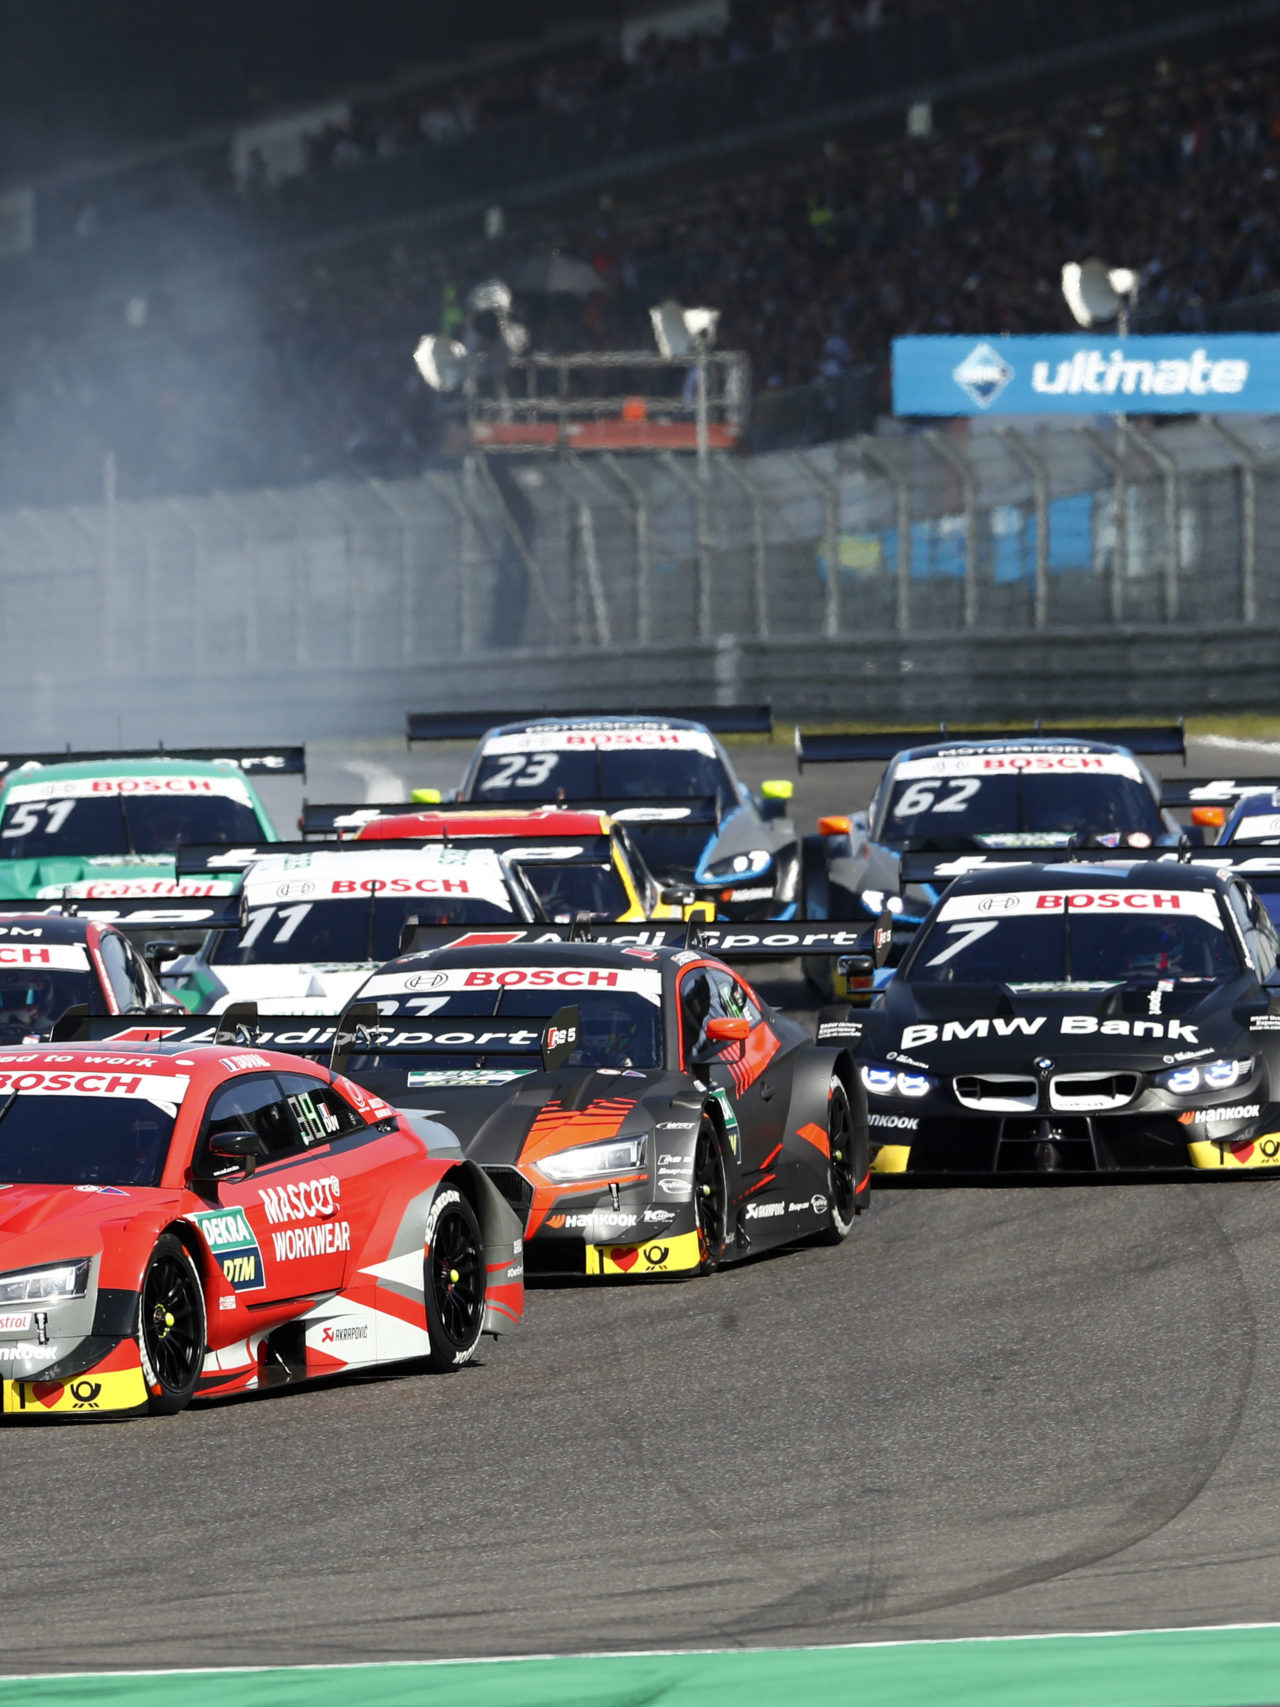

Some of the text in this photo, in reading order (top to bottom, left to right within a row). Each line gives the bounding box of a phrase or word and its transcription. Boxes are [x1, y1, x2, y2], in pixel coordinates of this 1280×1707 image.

[1031, 349, 1249, 394] ultimate
[567, 734, 680, 745] BOSCH
[480, 752, 559, 790] 23
[984, 758, 1103, 769] BOSCH
[91, 780, 212, 792] BOSCH
[894, 778, 982, 817] 62
[2, 799, 76, 840] 51
[331, 880, 469, 894] BOSCH
[1035, 894, 1181, 909] BOSCH
[238, 903, 314, 948] 11
[925, 921, 999, 967] 7
[463, 970, 619, 987] BOSCH
[901, 1015, 1199, 1050] BMW Bank
[43, 1052, 75, 1065] to
[84, 1055, 158, 1068] work
[202, 1215, 251, 1246] DEKRA
[271, 1221, 351, 1262] WORKWEAR
[223, 1256, 256, 1282] DTM
